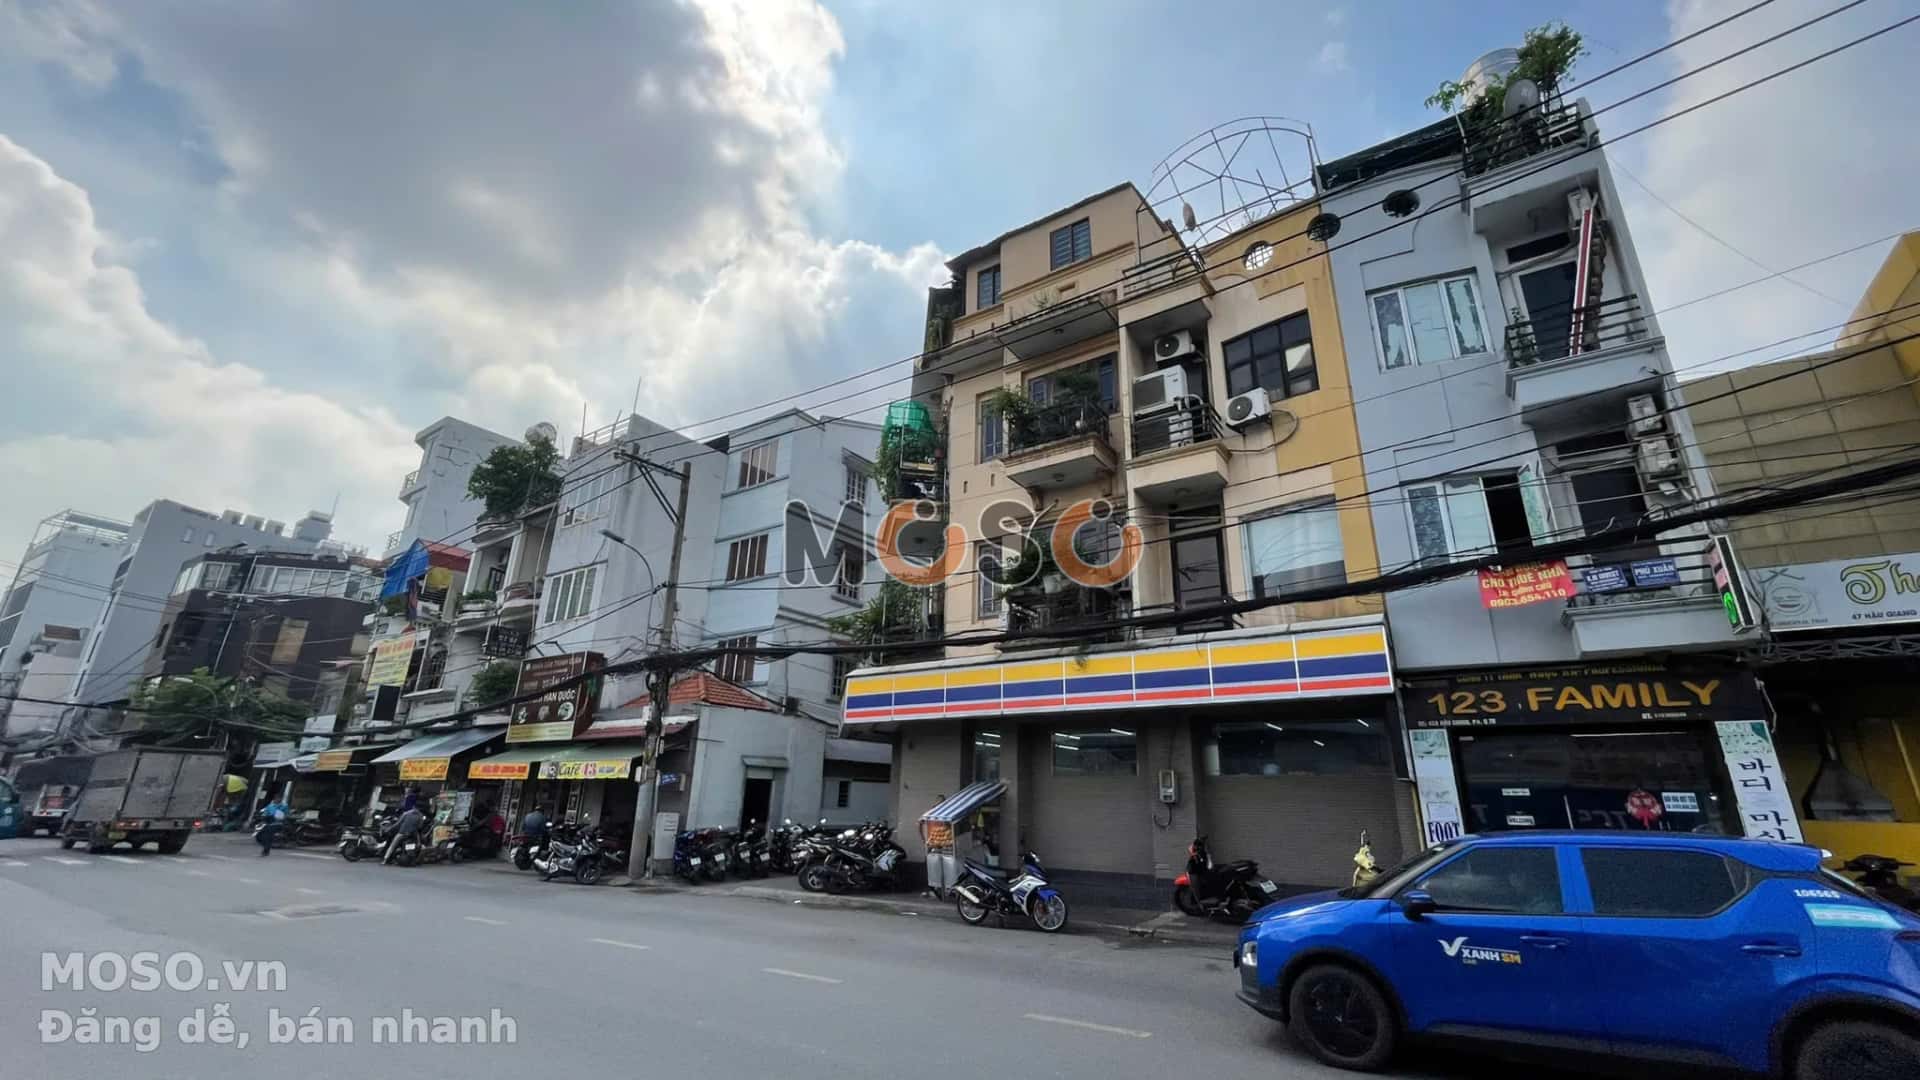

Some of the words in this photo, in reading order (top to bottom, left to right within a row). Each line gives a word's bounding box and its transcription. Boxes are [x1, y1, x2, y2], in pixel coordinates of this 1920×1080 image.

[1840, 560, 1920, 606] Th
[1427, 690, 1507, 716] 123
[1526, 679, 1720, 711] FAMILY
[1428, 821, 1461, 843] FOOT
[1462, 948, 1500, 961] XANH
